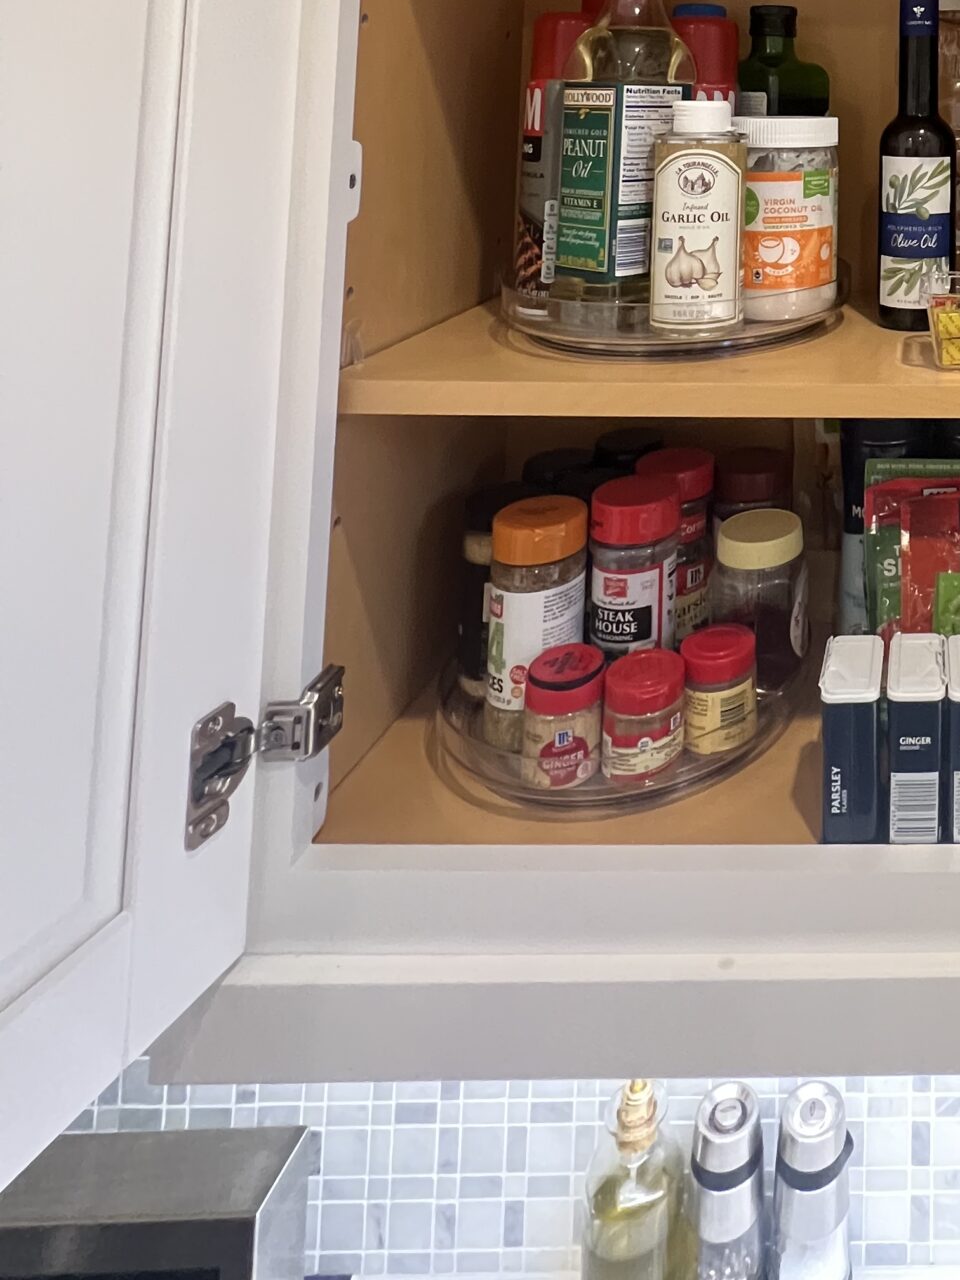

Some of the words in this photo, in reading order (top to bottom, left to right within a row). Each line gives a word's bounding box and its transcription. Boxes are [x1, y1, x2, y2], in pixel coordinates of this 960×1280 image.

[590, 129, 608, 137] GOLD
[563, 139, 606, 158] PEANUT
[572, 160, 593, 179] Oil
[675, 168, 682, 177] LA
[682, 161, 719, 176] TOURANGELLE
[563, 197, 592, 208] VITAMIN
[682, 202, 709, 212] Infused
[763, 198, 796, 206] VIRGIN
[661, 211, 706, 224] GARLIC
[710, 211, 730, 223] OIL
[763, 206, 808, 215] COCONUT
[890, 234, 919, 248] Olive
[921, 233, 938, 248] Oil
[597, 608, 635, 622] STEAK
[595, 619, 638, 634] HOUSE
[899, 736, 931, 745] GINGER
[541, 750, 584, 770] GINGER
[831, 766, 841, 814] PARSLEY
